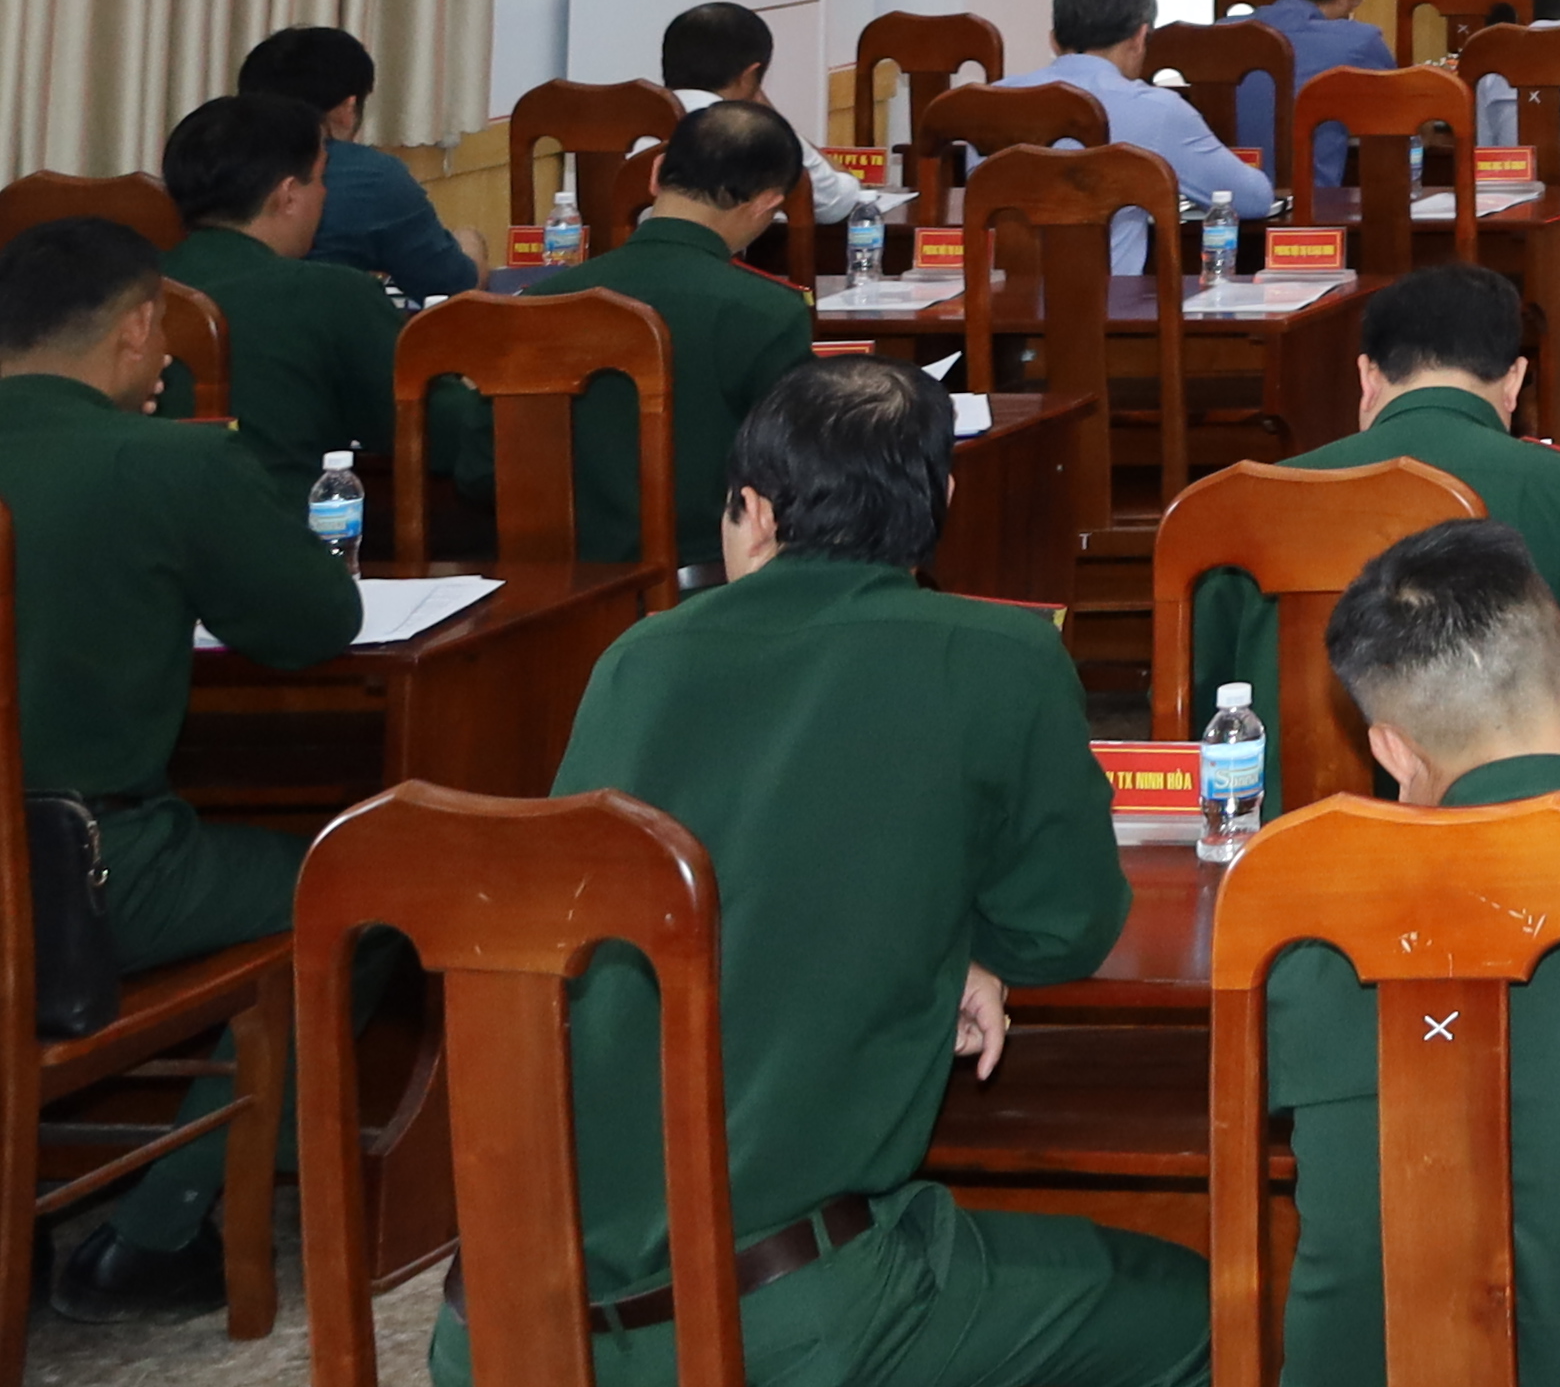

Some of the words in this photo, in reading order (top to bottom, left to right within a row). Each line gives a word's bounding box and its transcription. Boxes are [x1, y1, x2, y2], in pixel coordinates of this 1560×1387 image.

[1118, 772, 1132, 789] TX
[1136, 772, 1164, 789] NINH
[1167, 769, 1192, 790] HÒA
